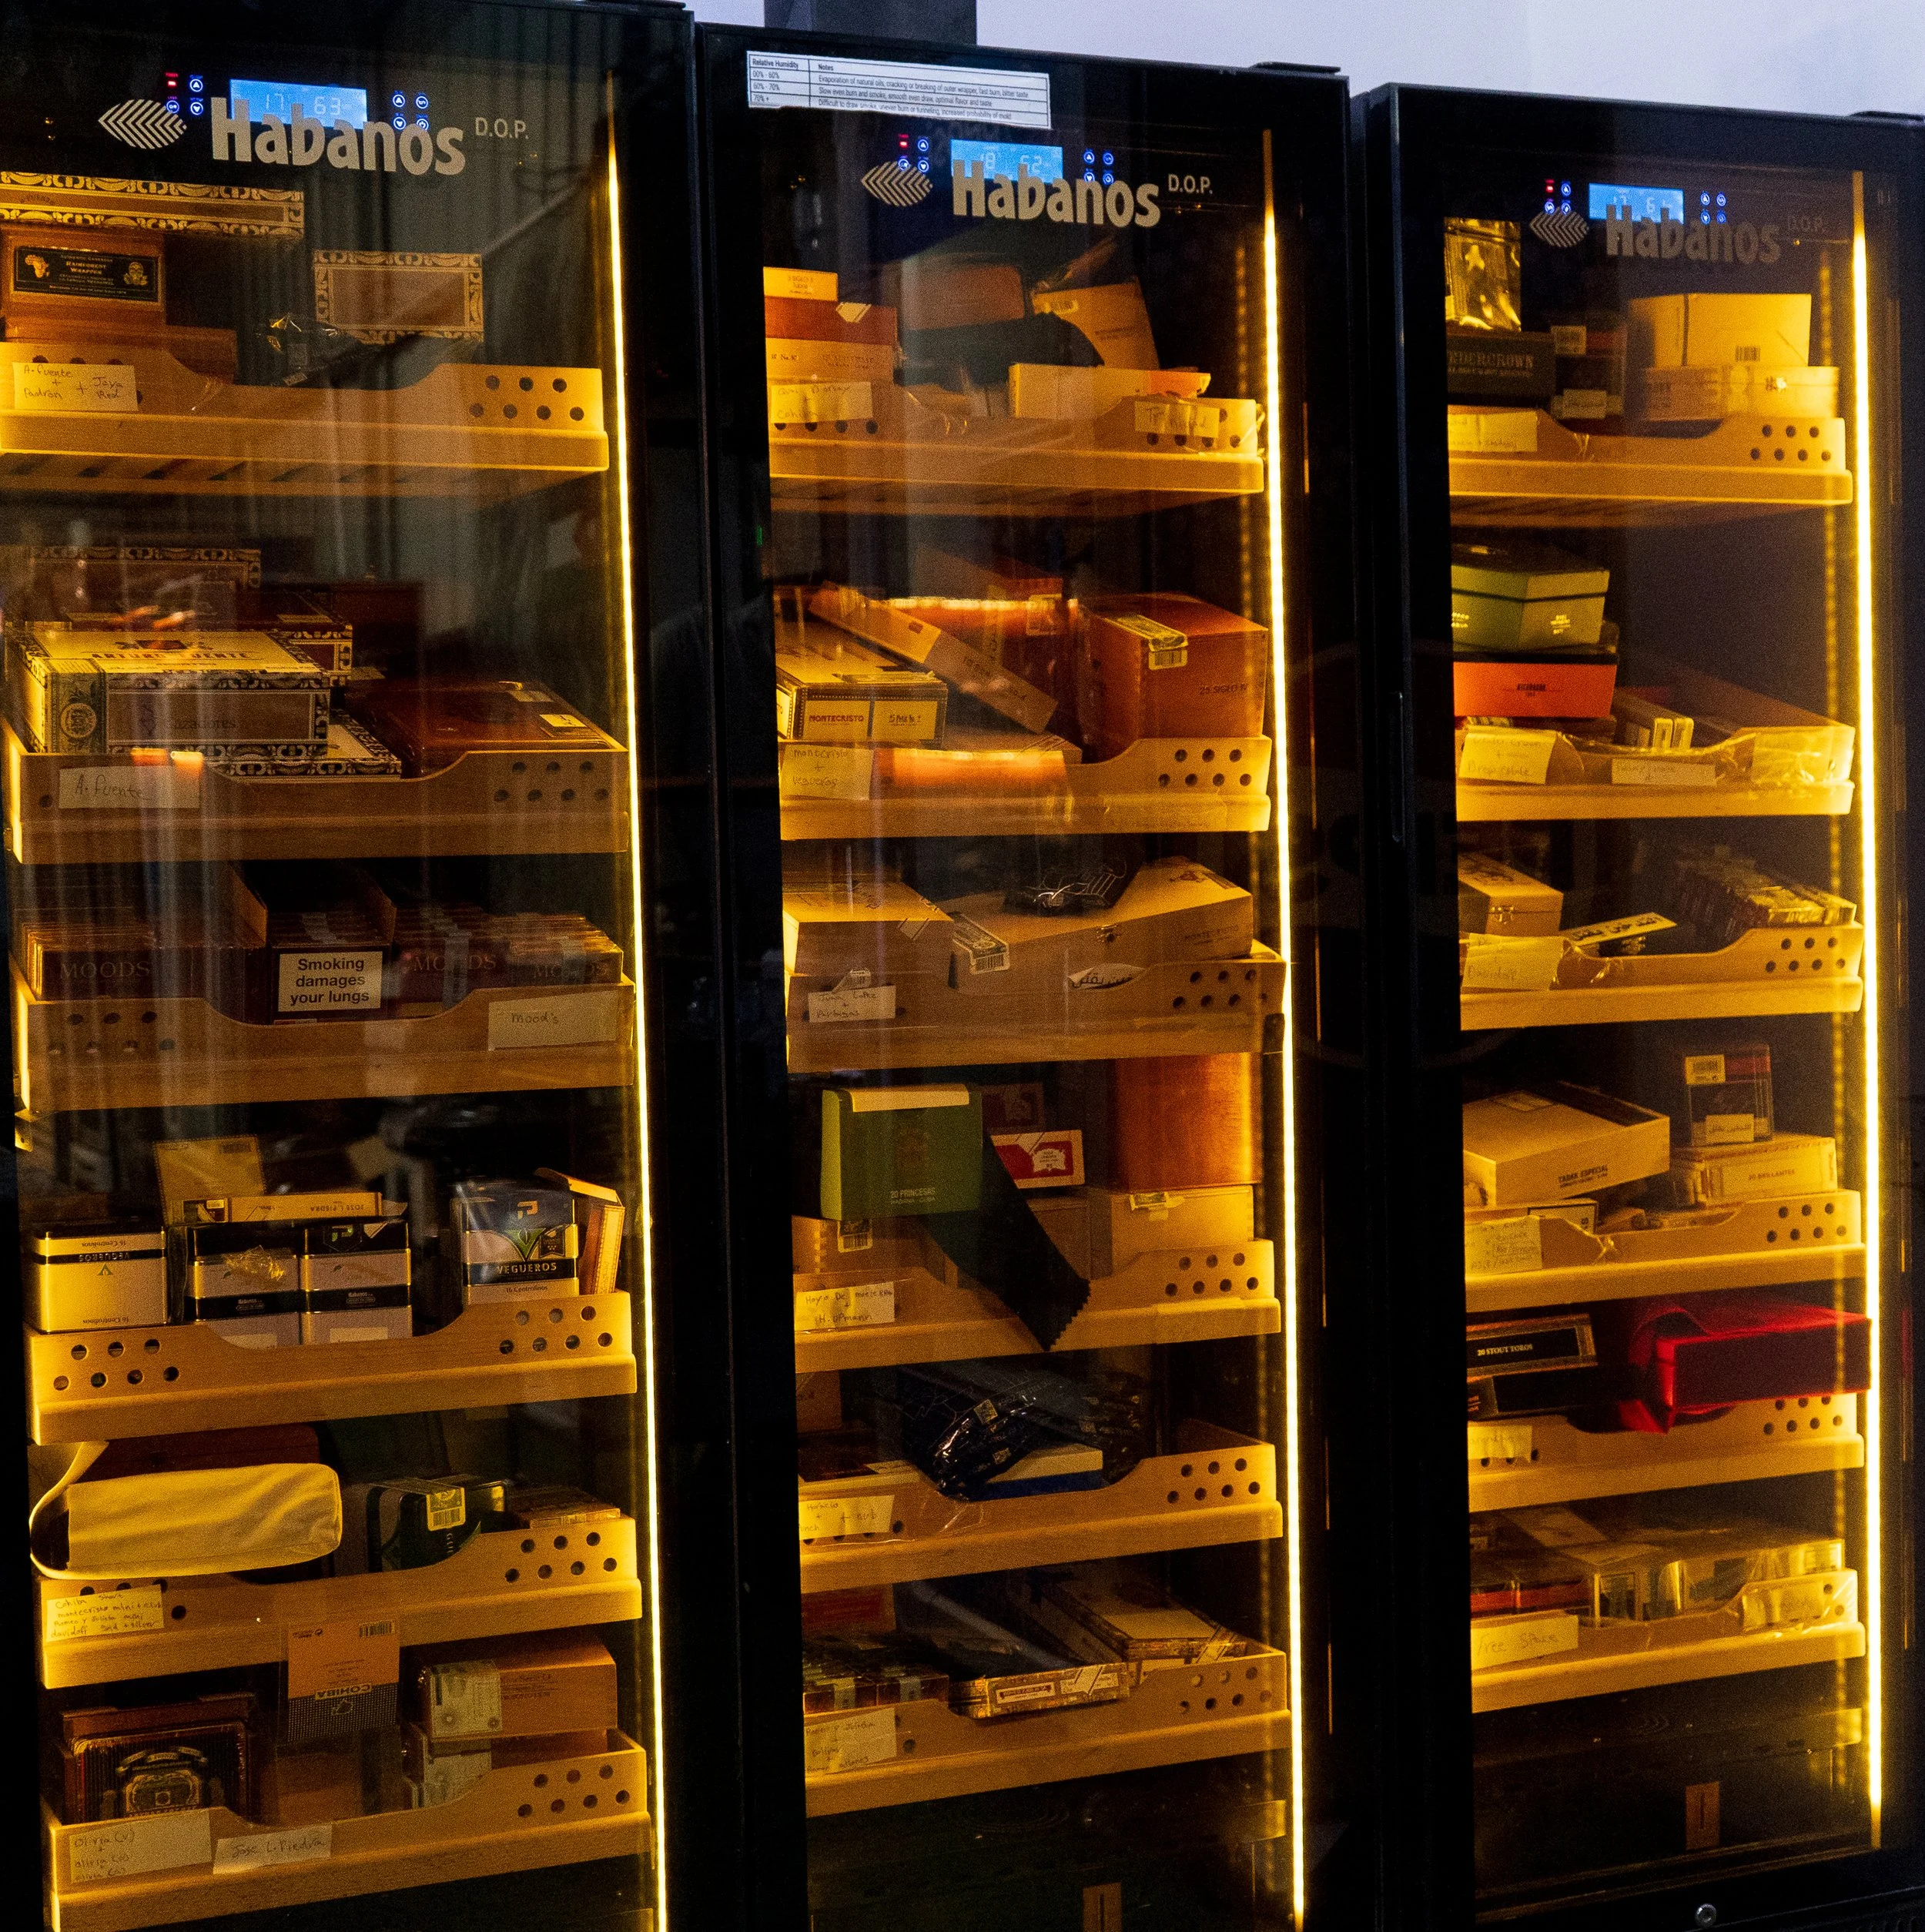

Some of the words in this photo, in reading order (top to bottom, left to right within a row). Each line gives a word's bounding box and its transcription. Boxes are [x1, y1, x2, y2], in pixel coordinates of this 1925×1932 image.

[775, 61, 798, 70] Humidity
[819, 75, 849, 84] Evaporation
[915, 82, 936, 92] breaking
[314, 95, 340, 116] 63
[819, 99, 839, 107] Difficult
[210, 97, 465, 176] Habanos
[475, 117, 530, 140] D.O.P.
[952, 160, 1161, 227] Habanos
[1168, 174, 1213, 196] D.O.P.
[1605, 204, 1781, 264] Habanos
[60, 961, 150, 979] MOODS
[298, 958, 364, 971] Smoking
[413, 955, 497, 972] MODS
[534, 963, 607, 979] MODS
[296, 975, 365, 988] damages
[290, 993, 324, 1006] your
[329, 990, 369, 1004] lungs
[79, 1252, 130, 1262] VEGUEROS
[497, 1262, 557, 1274] VEGUEROS
[1486, 1346, 1508, 1354] STOUT
[317, 1685, 370, 1697] COHIBA
